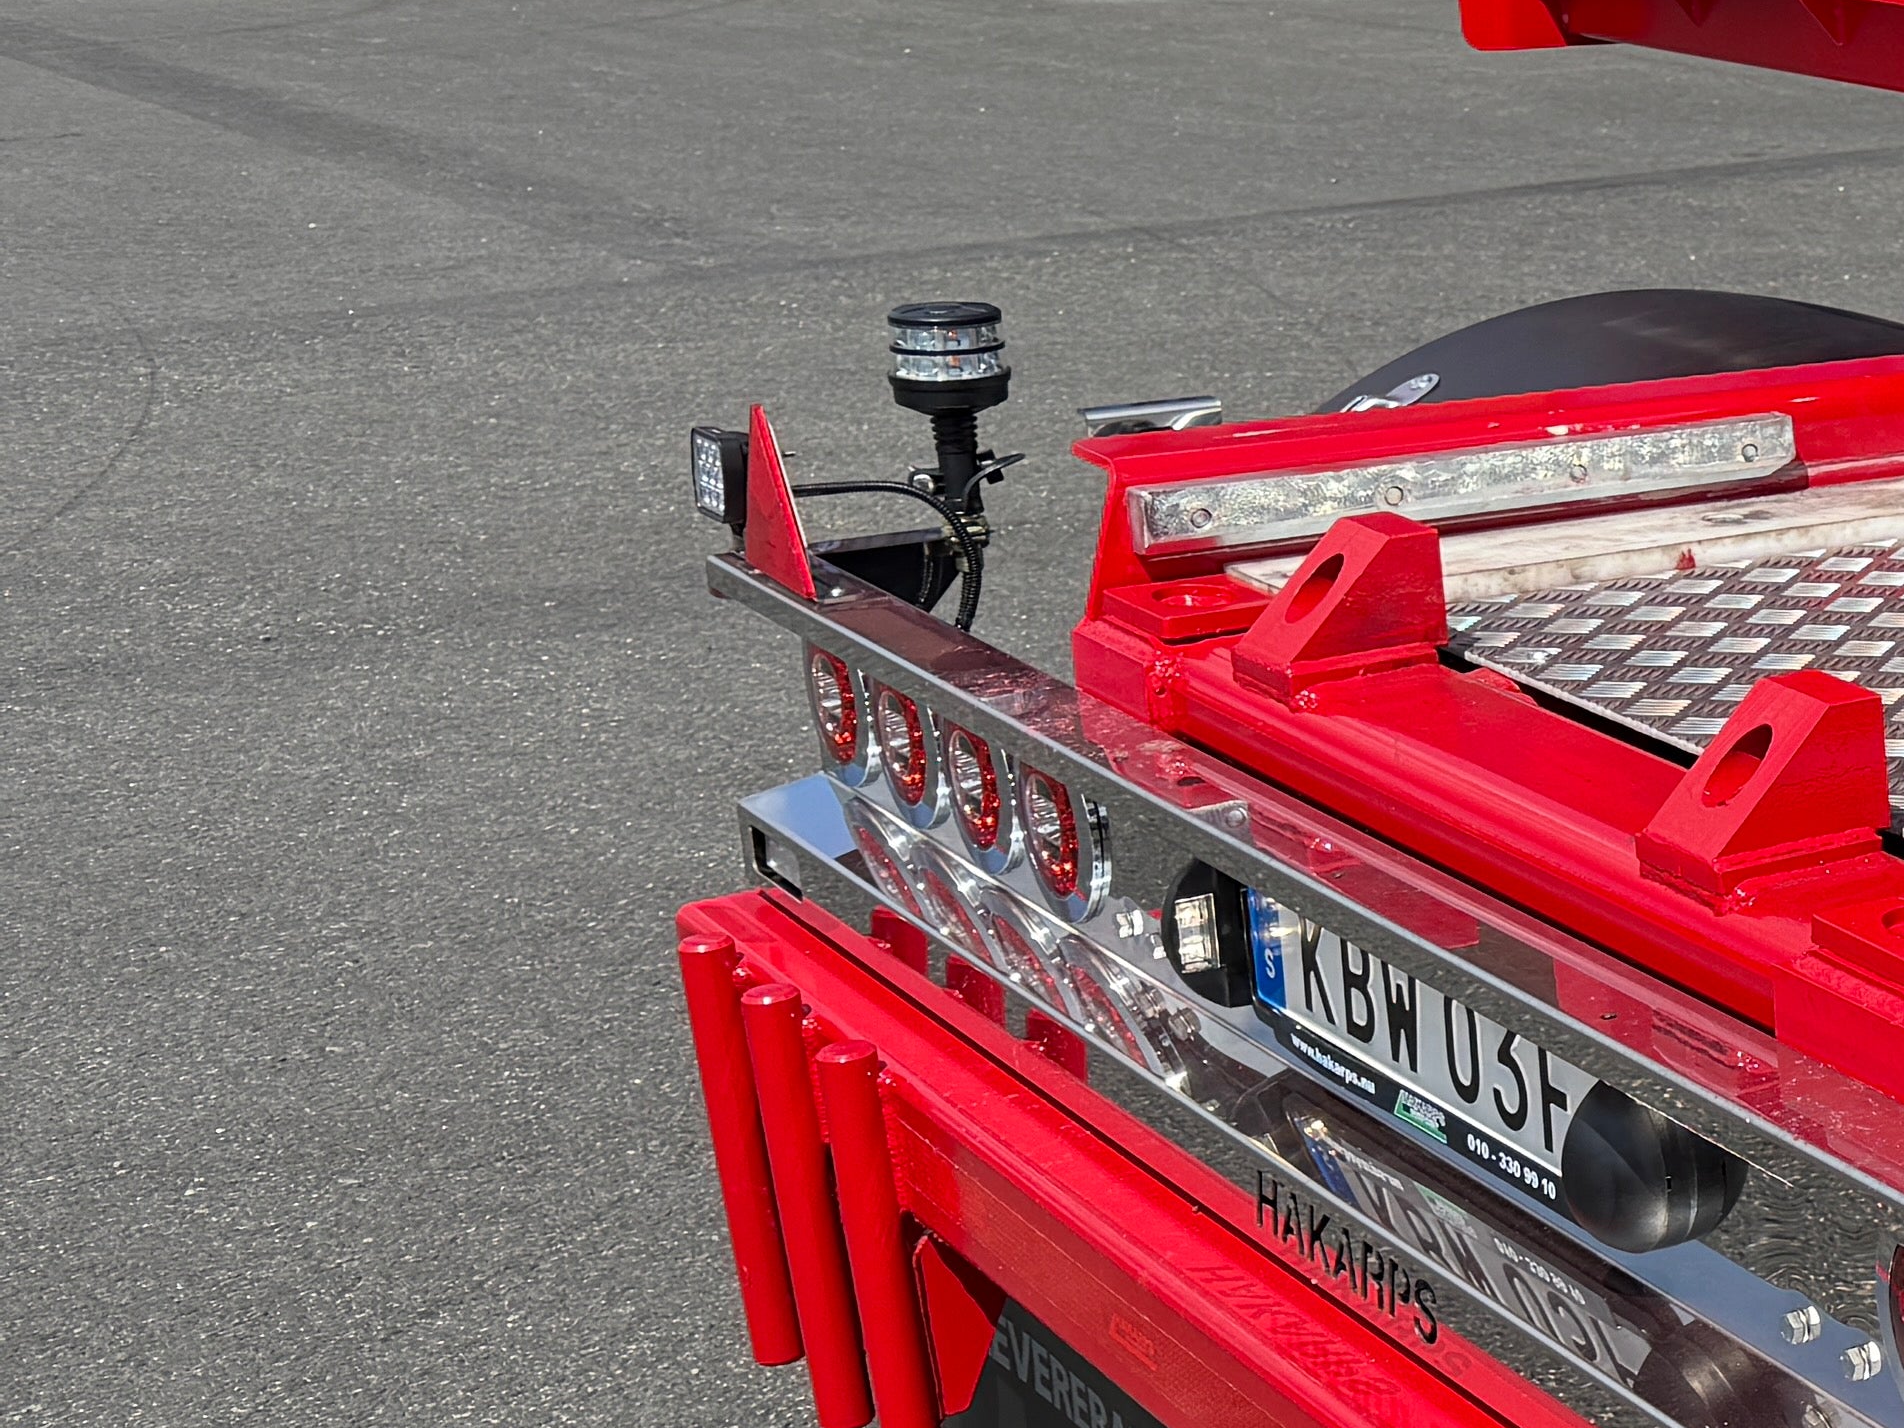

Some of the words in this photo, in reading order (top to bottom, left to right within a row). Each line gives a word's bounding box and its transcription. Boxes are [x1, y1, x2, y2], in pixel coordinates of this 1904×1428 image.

[1264, 949, 1277, 980] S
[1300, 917, 1419, 1074] KBW
[1466, 1133, 1489, 1160] 010
[1499, 1151, 1521, 1179] 330
[1523, 1167, 1540, 1190] 99
[1541, 1177, 1557, 1200] 10
[1255, 1170, 1438, 1345] HAKARPS
